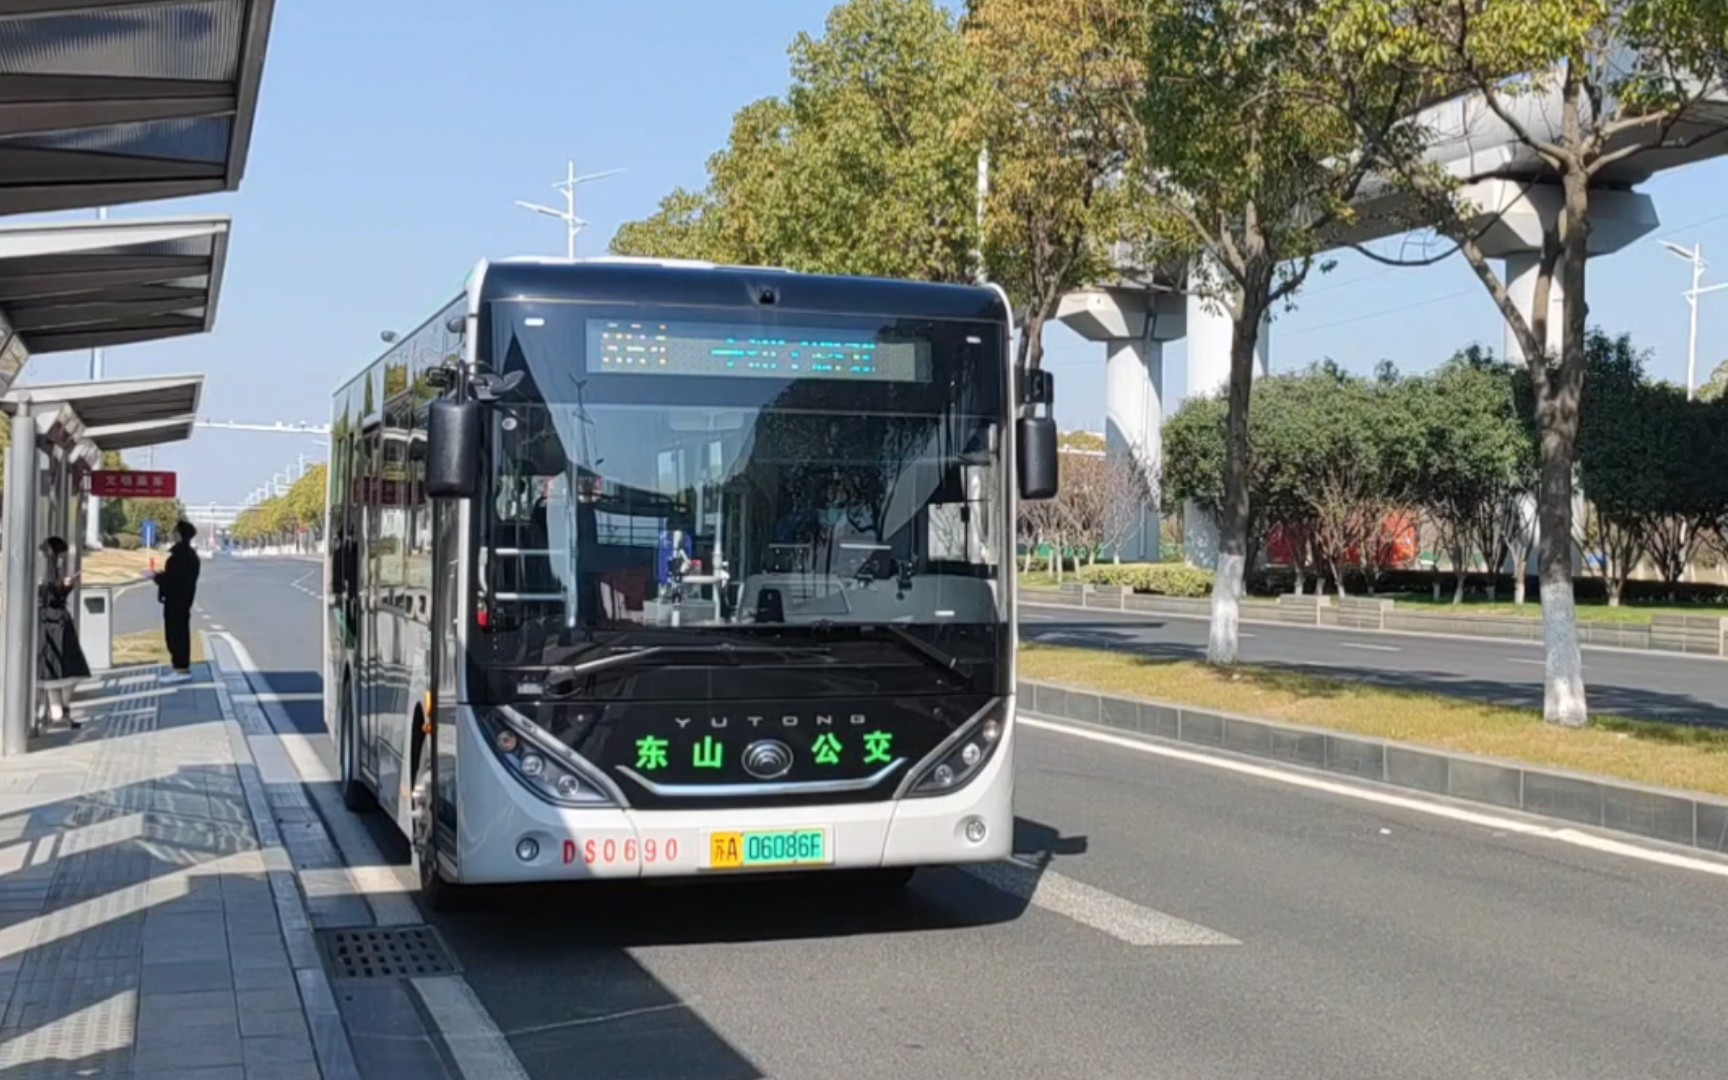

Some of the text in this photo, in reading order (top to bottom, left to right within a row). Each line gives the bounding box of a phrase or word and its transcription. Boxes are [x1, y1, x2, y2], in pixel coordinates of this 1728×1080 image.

[675, 714, 865, 728] YUTONG
[635, 732, 893, 769] 东山 公交
[562, 838, 678, 865] DS0690
